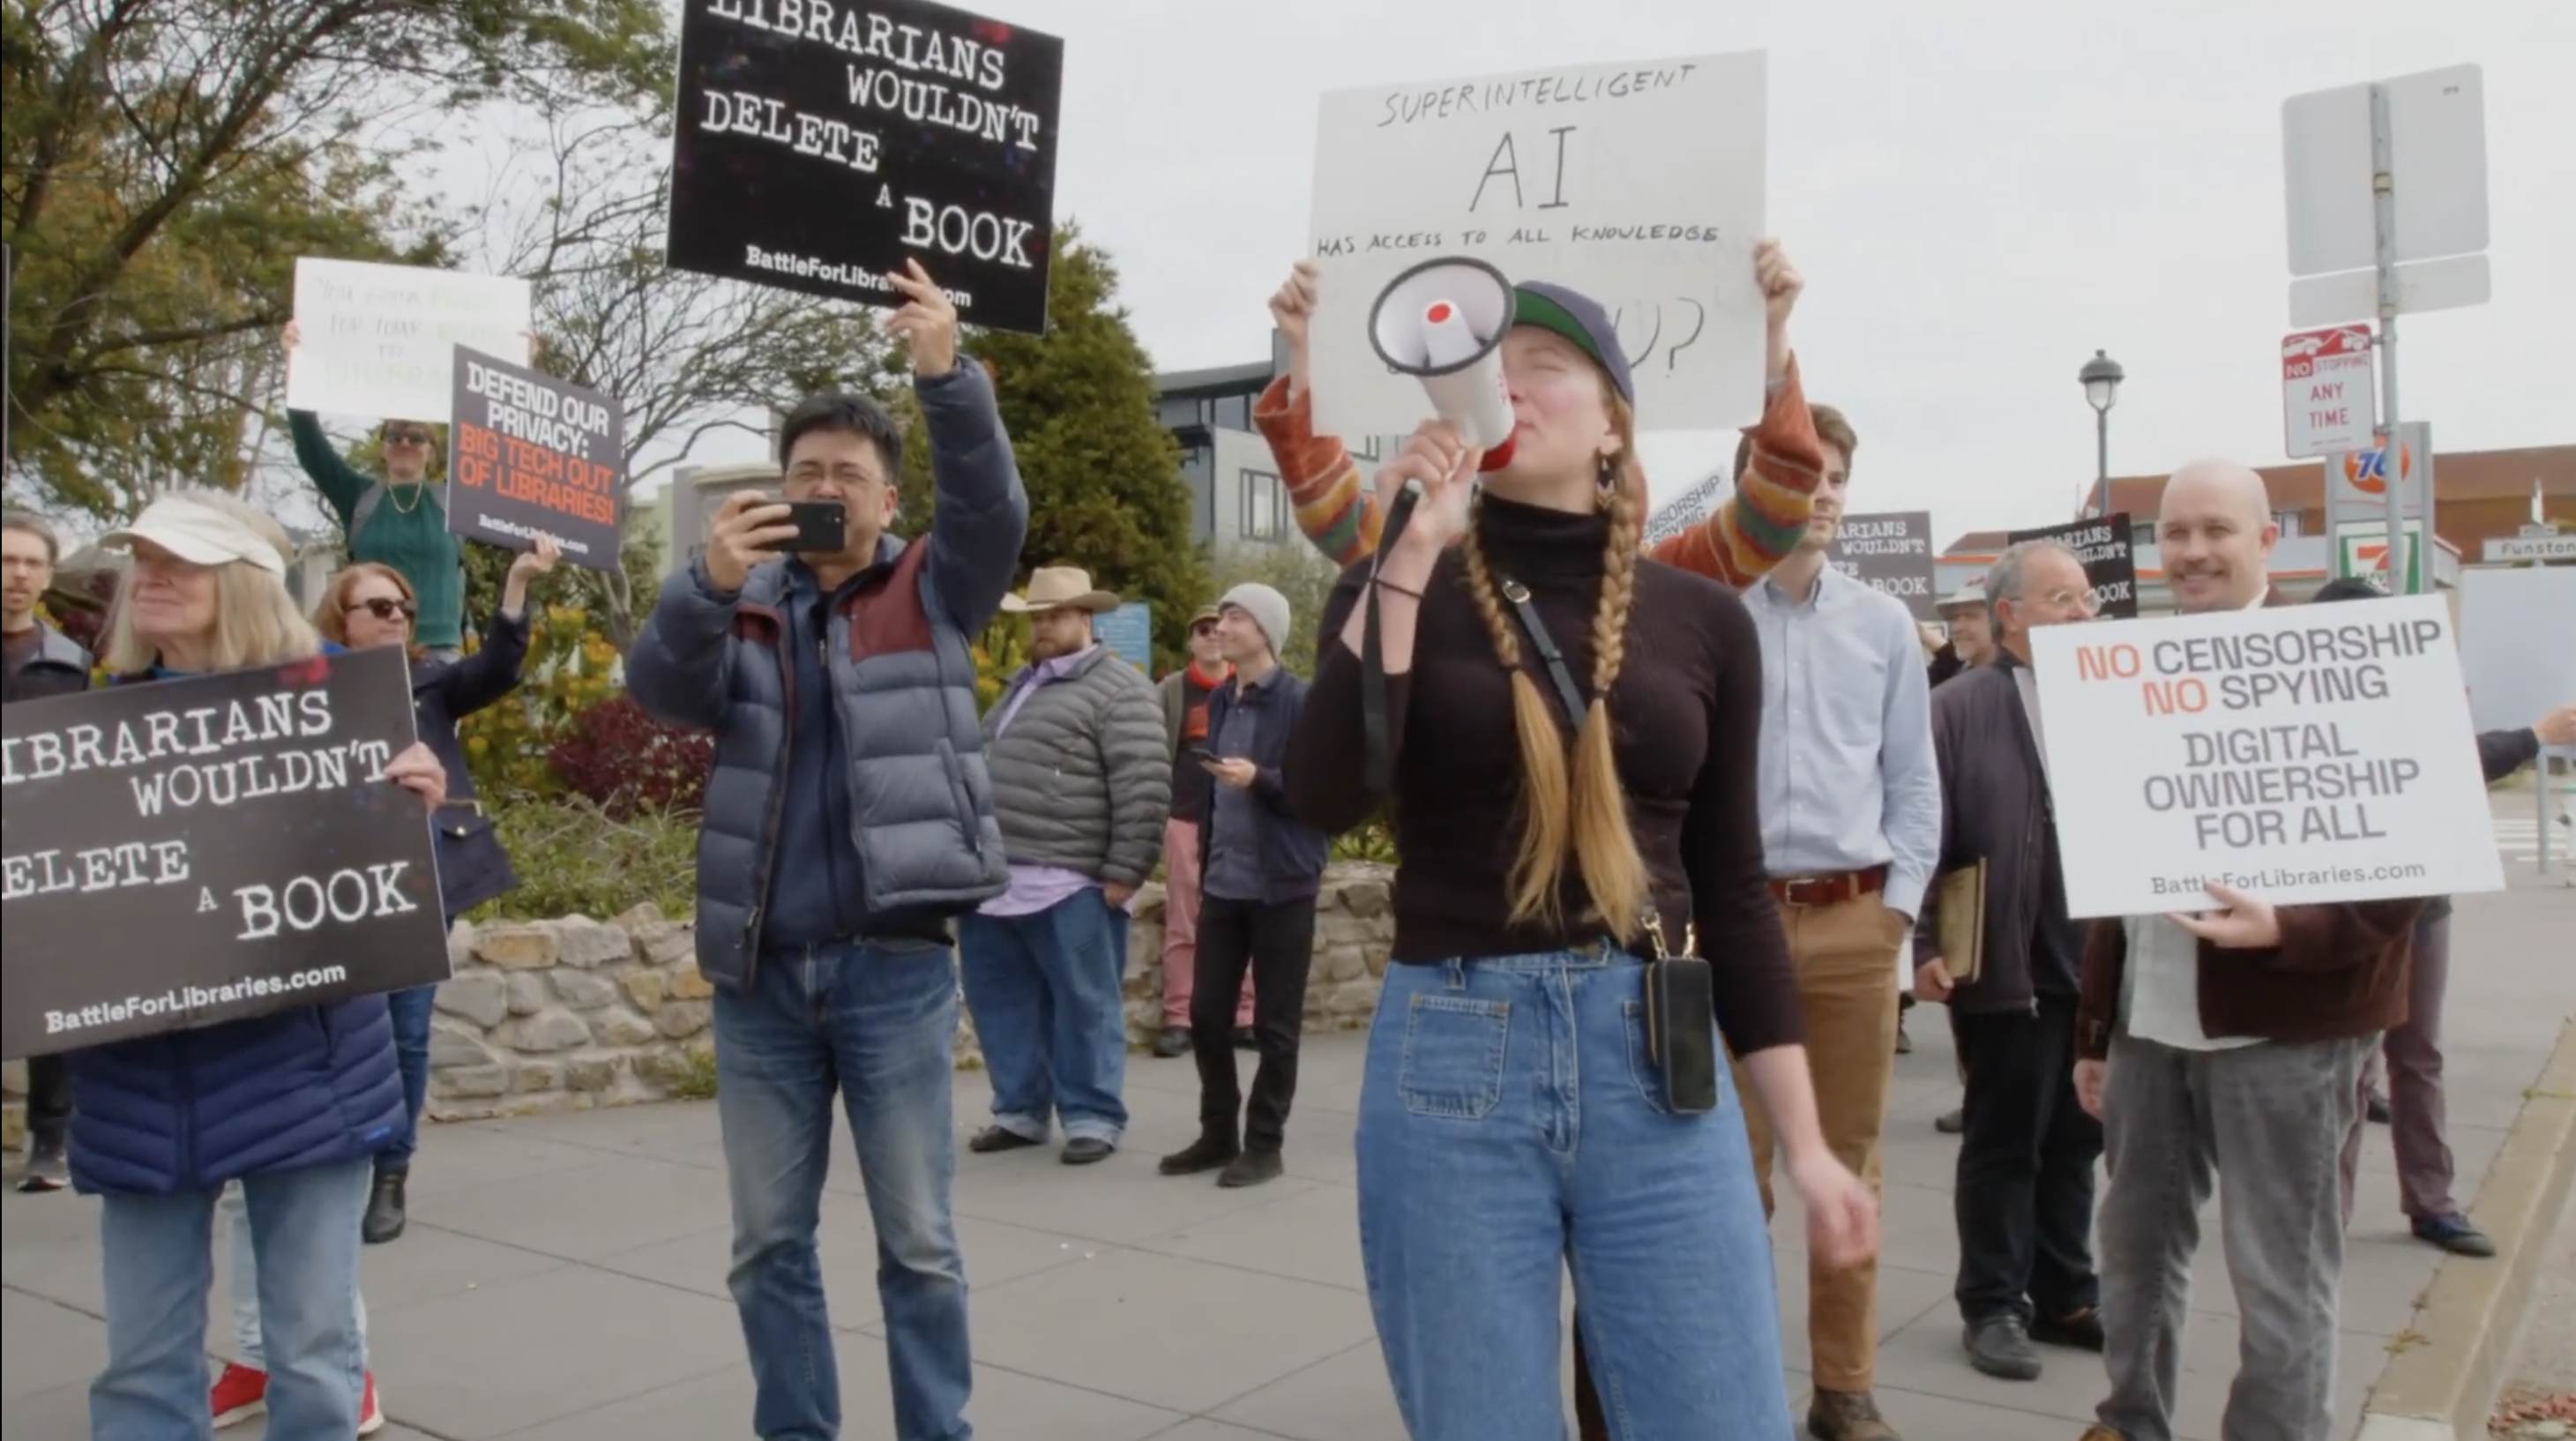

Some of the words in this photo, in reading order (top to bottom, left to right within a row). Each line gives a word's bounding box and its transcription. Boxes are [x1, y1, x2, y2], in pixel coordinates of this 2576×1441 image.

[846, 64, 1039, 151] WOULDN'T
[1376, 63, 1699, 128] SUPERINTELLIGENT
[700, 90, 880, 173] DELETE
[1468, 125, 1578, 213] AI
[876, 183, 892, 208] A
[901, 196, 1034, 267] BOOK
[1318, 237, 1356, 258] HAS
[1366, 232, 1443, 251] ACCESS
[1461, 229, 1487, 245] TO
[1508, 227, 1550, 244] ALL
[1572, 224, 1721, 243] KNOWLEDGE
[745, 244, 972, 307] BattleForLibraom
[466, 361, 559, 419] DEFEND
[562, 395, 610, 437] OUR
[2286, 362, 2311, 378] NO
[2310, 381, 2344, 401] ANY
[486, 399, 590, 460] PRIVACY:
[2309, 407, 2350, 429] TIME
[458, 421, 499, 462] BIG
[504, 437, 564, 481] TECH
[568, 458, 615, 494] OUT
[458, 455, 491, 488] OF
[496, 465, 615, 526] LIBRARIES!
[2501, 540, 2576, 557] Funston
[2076, 643, 2142, 681] NO
[2153, 619, 2442, 675] CENSORSHIP
[2142, 678, 2208, 716] NO
[2220, 664, 2389, 711] SPYING
[2182, 721, 2359, 768] DIGITAL
[129, 739, 390, 817] WOULDN'T
[2143, 758, 2421, 812] OWNERSHIP
[2194, 810, 2287, 851] FOR
[2299, 803, 2387, 844] ALL
[197, 885, 219, 914] A
[233, 861, 417, 941] BOOK
[45, 965, 347, 1034] BattleForLibraries.com
